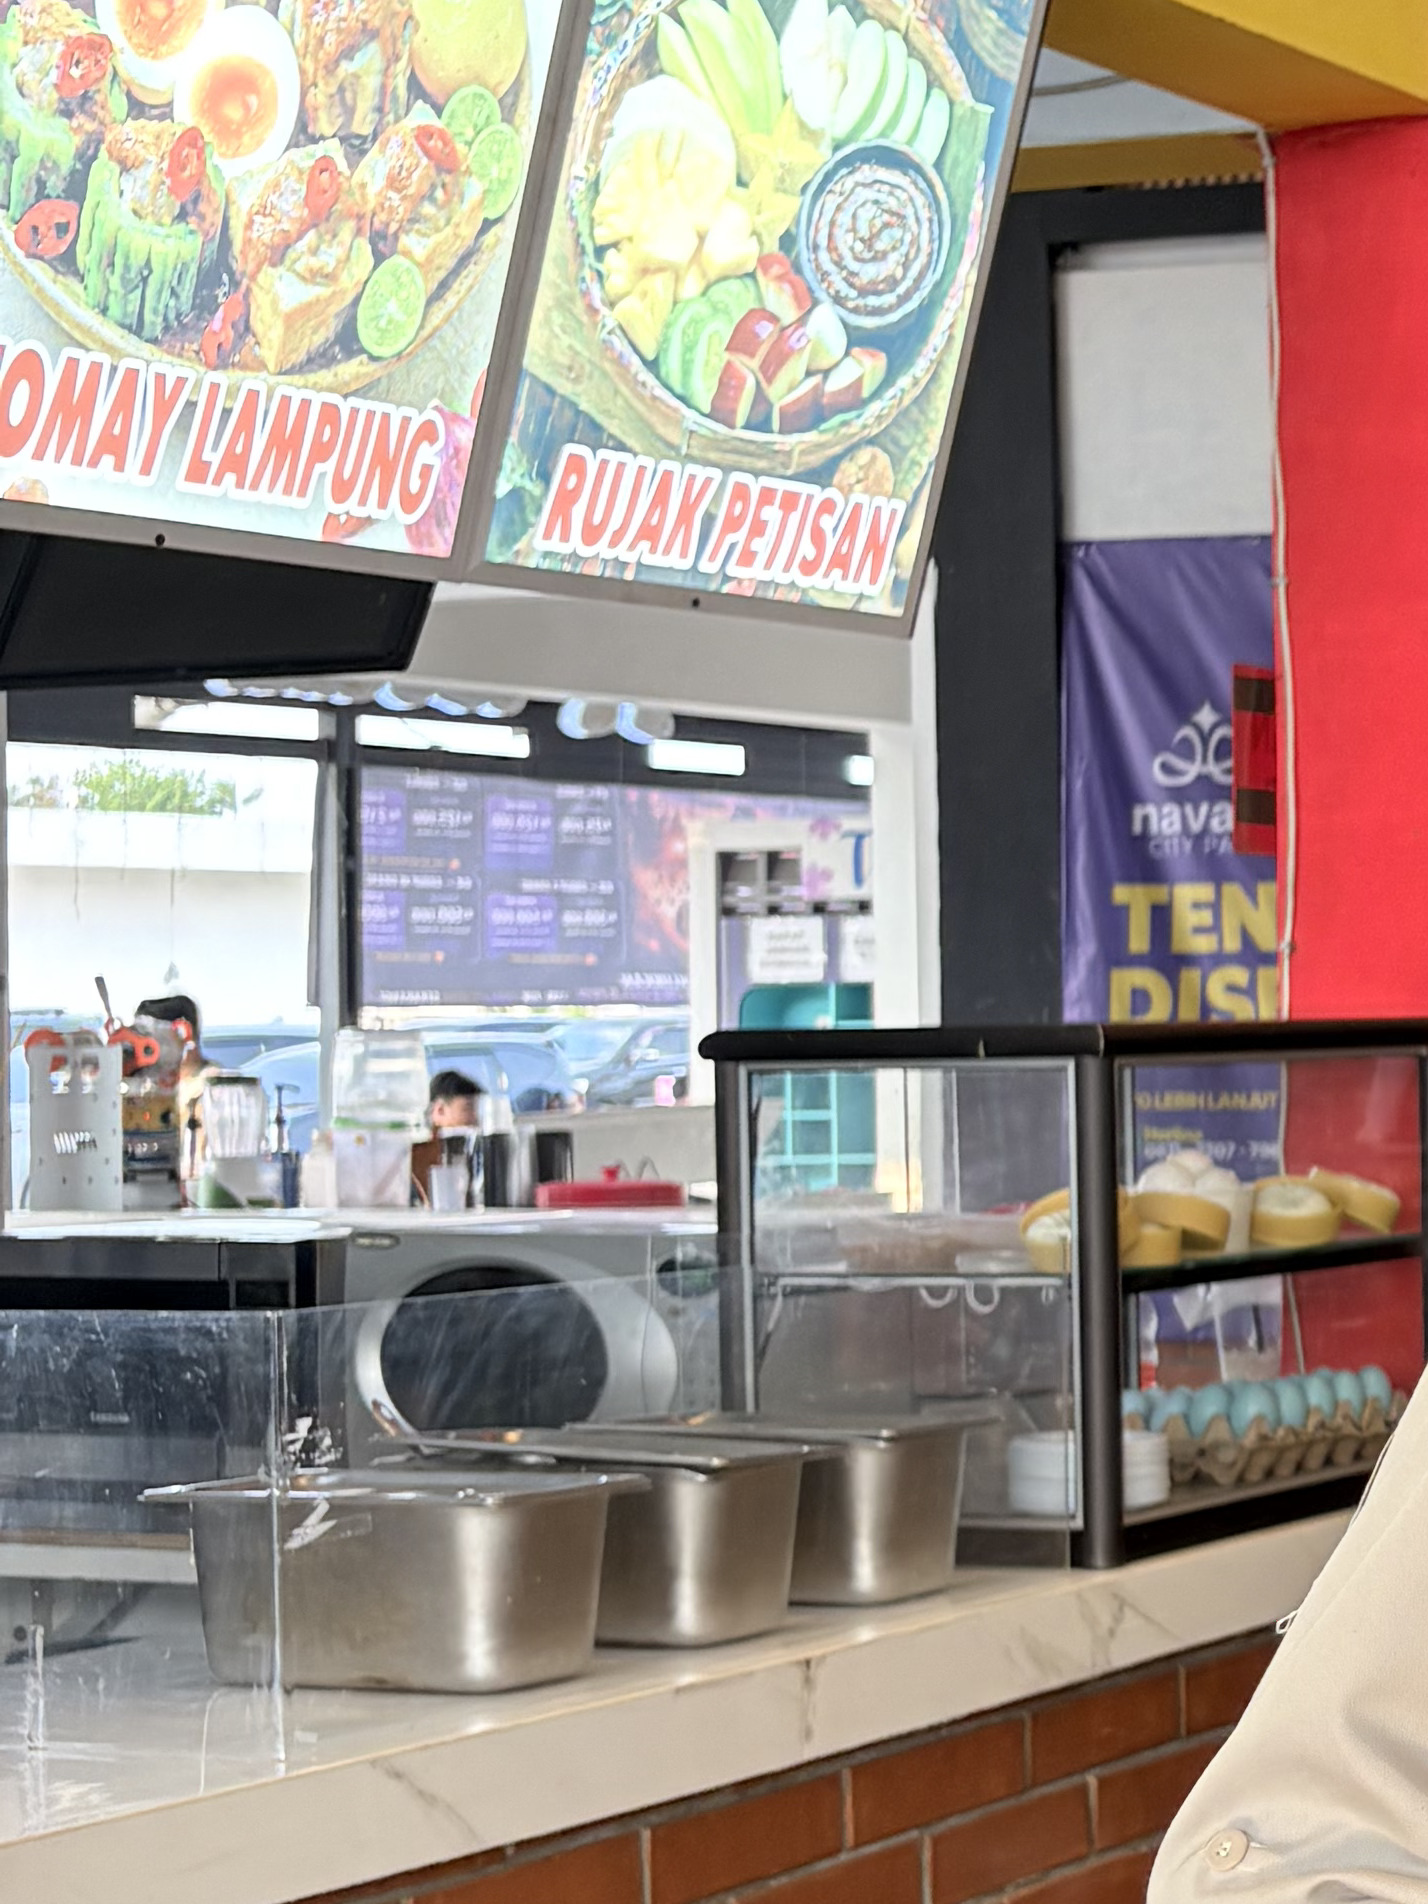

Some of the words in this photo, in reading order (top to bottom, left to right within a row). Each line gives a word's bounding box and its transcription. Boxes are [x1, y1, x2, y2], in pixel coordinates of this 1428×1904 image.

[0, 345, 190, 477] OMAY
[184, 381, 441, 516] LAMPUNG
[542, 452, 713, 560] RUJAK
[706, 480, 898, 586] PETISAN
[1132, 800, 1233, 837] nava
